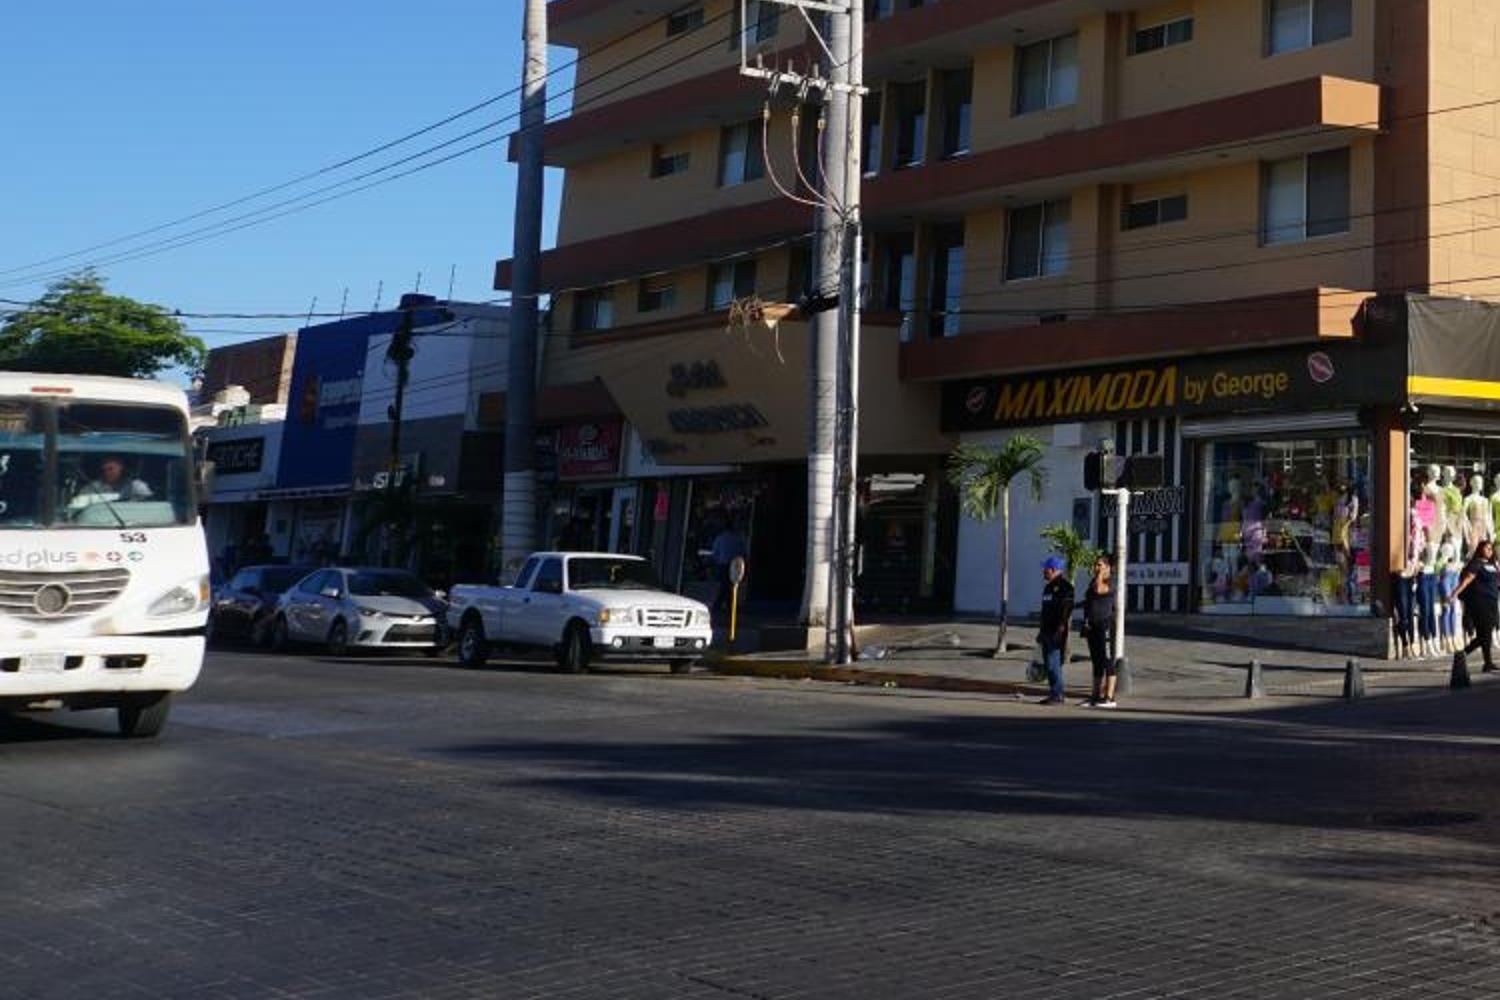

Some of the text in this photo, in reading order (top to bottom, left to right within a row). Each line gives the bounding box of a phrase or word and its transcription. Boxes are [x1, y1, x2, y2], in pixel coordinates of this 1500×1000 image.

[993, 364, 1290, 421] MAXIMODA by George
[119, 531, 148, 544] 53
